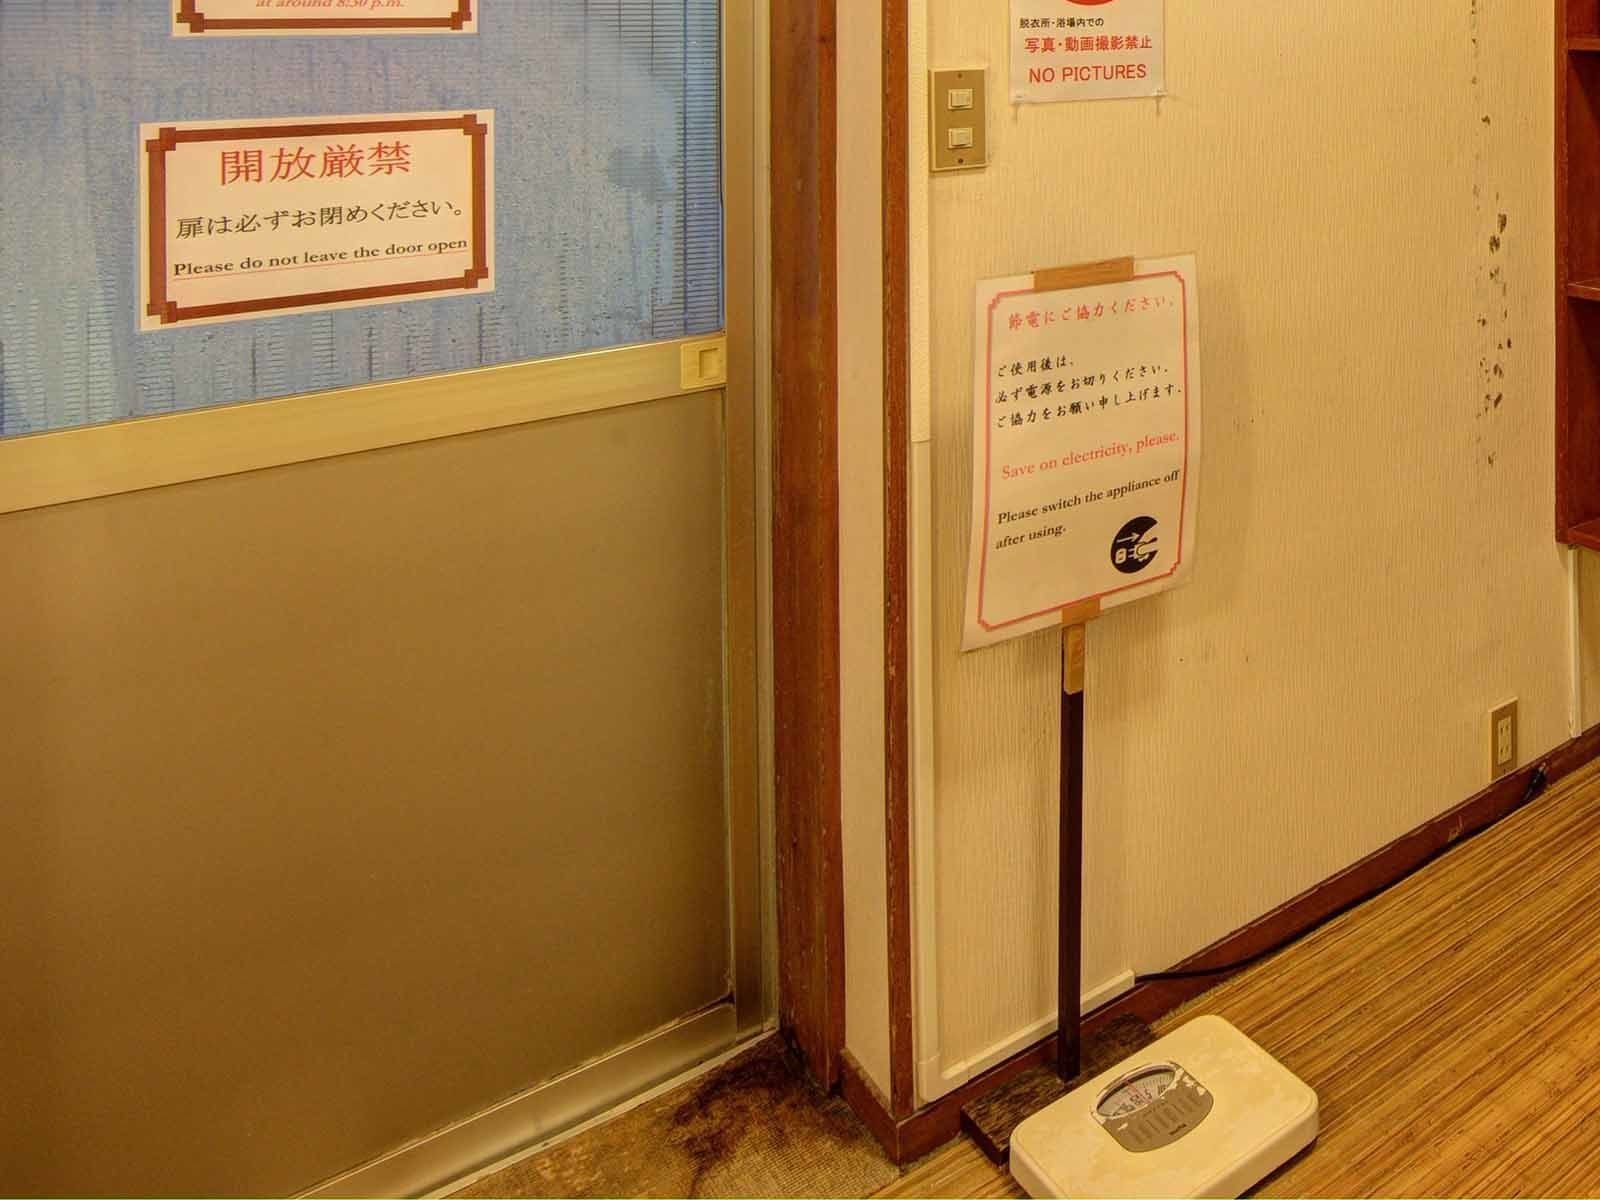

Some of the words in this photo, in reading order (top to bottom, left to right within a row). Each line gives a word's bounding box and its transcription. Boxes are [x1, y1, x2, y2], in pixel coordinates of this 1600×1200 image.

[370, 0, 405, 10] p.m.
[1024, 34, 1153, 54] 写真・動画撮影禁止
[1029, 67, 1056, 83] NO
[1062, 63, 1147, 81] PICTURES
[221, 141, 412, 186] 開放厳禁
[176, 199, 464, 239] 扉は必ずお閉めください。
[173, 262, 234, 276] Please
[240, 257, 263, 270] do
[269, 255, 298, 266] not
[304, 250, 347, 263] leave
[353, 246, 381, 258] the
[385, 243, 424, 256] door
[428, 239, 468, 253] open
[1001, 460, 1035, 480] Save
[1040, 459, 1058, 471] on
[1063, 442, 1133, 467] electricity,
[1136, 431, 1180, 450] please.
[998, 506, 1038, 524] Please
[1041, 496, 1081, 514] switch
[1085, 490, 1103, 504] the
[1106, 477, 1161, 498] appliance
[1164, 469, 1180, 484] off
[996, 534, 1025, 549] after
[1029, 524, 1066, 538] using.
